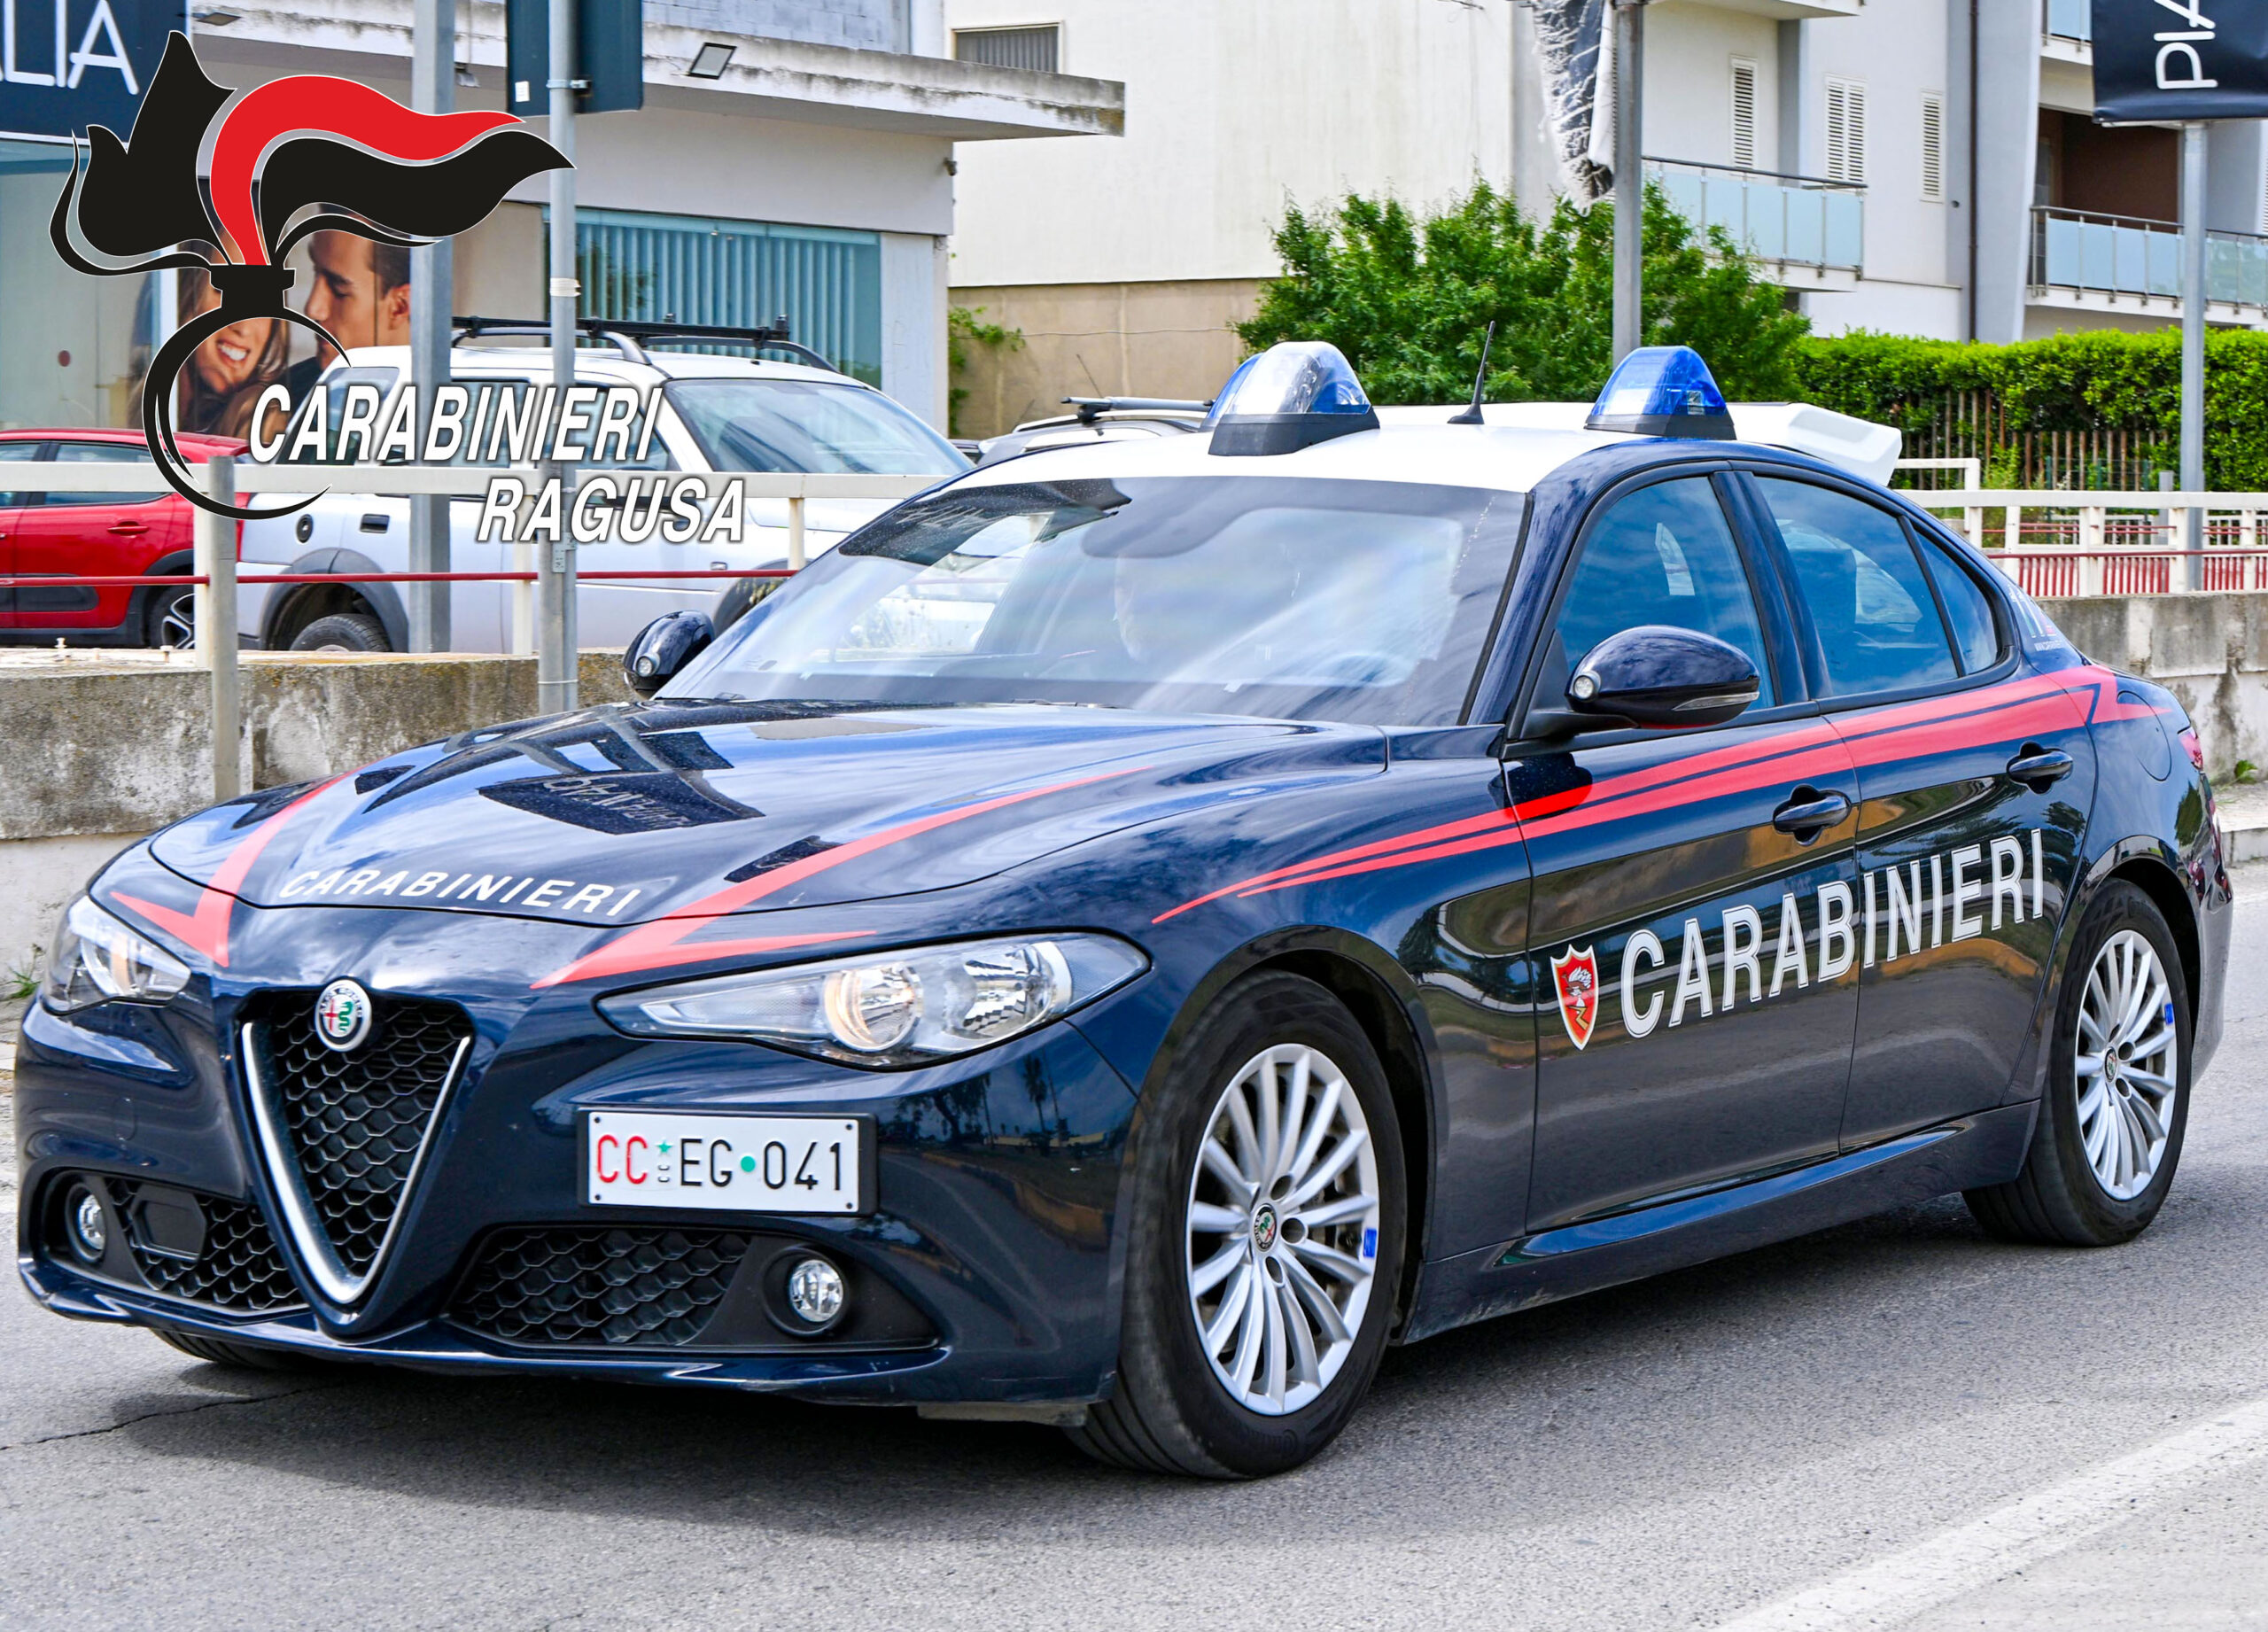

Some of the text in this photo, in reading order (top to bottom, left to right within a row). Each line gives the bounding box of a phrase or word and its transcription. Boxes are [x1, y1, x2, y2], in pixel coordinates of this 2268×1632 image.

[0, 0, 139, 95] LIA
[278, 870, 641, 917] CARABINIERI
[1620, 828, 2043, 1039] CARABINIERI
